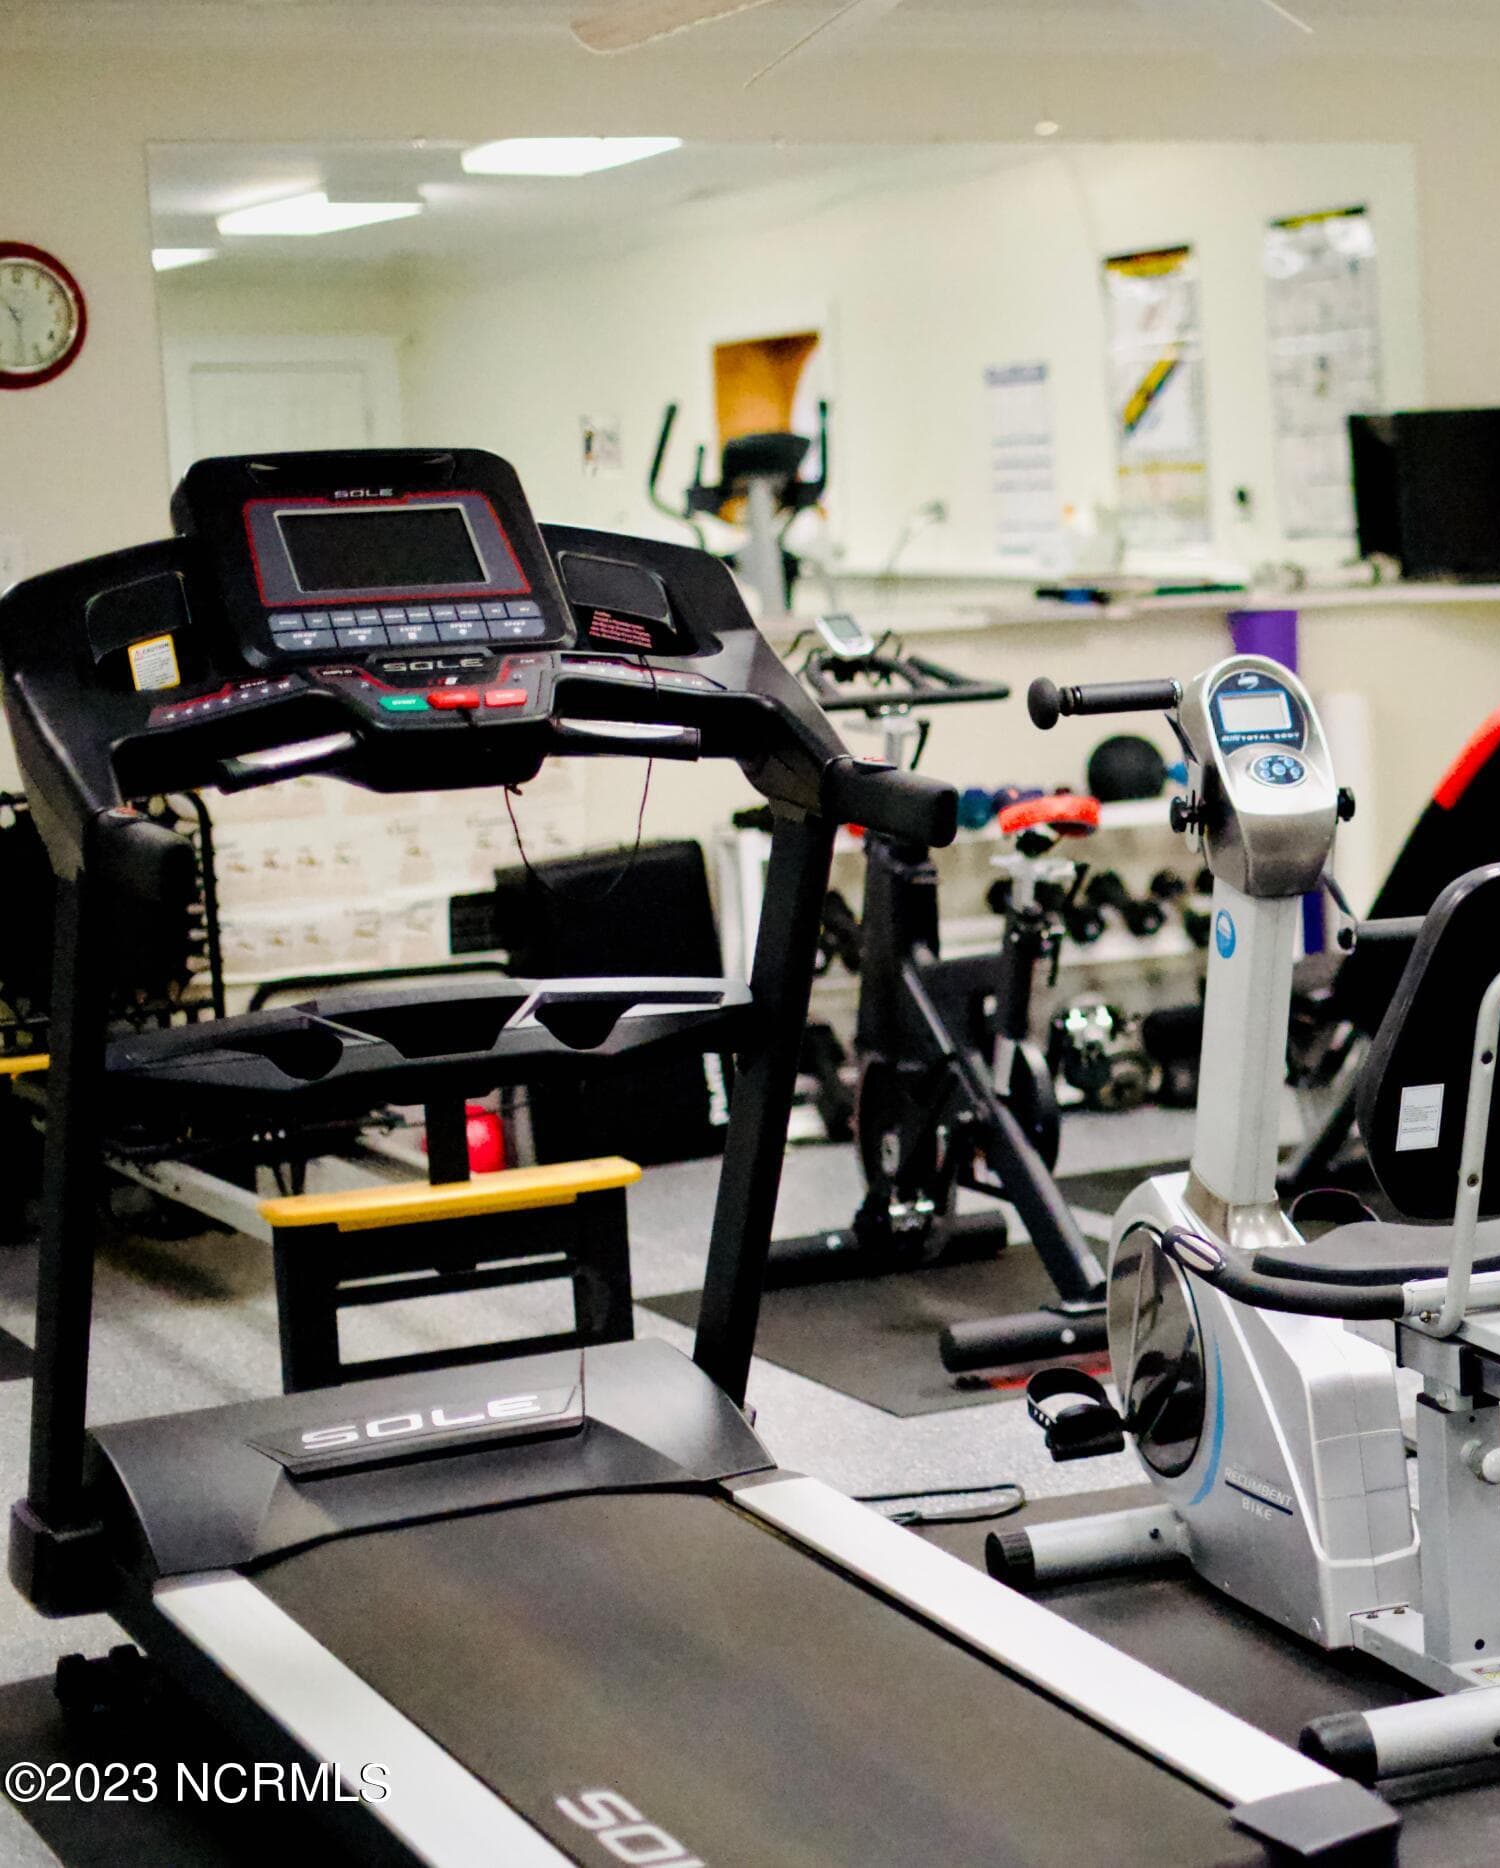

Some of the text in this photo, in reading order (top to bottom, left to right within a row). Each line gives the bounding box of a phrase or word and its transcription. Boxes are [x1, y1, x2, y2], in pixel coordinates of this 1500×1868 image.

[334, 487, 393, 499] SOLE
[383, 657, 484, 672] SOLE
[301, 1394, 542, 1450] SOLE
[1224, 1467, 1293, 1506] RECUMBENT
[1241, 1497, 1273, 1520] BIKE
[554, 1788, 706, 1868] SO
